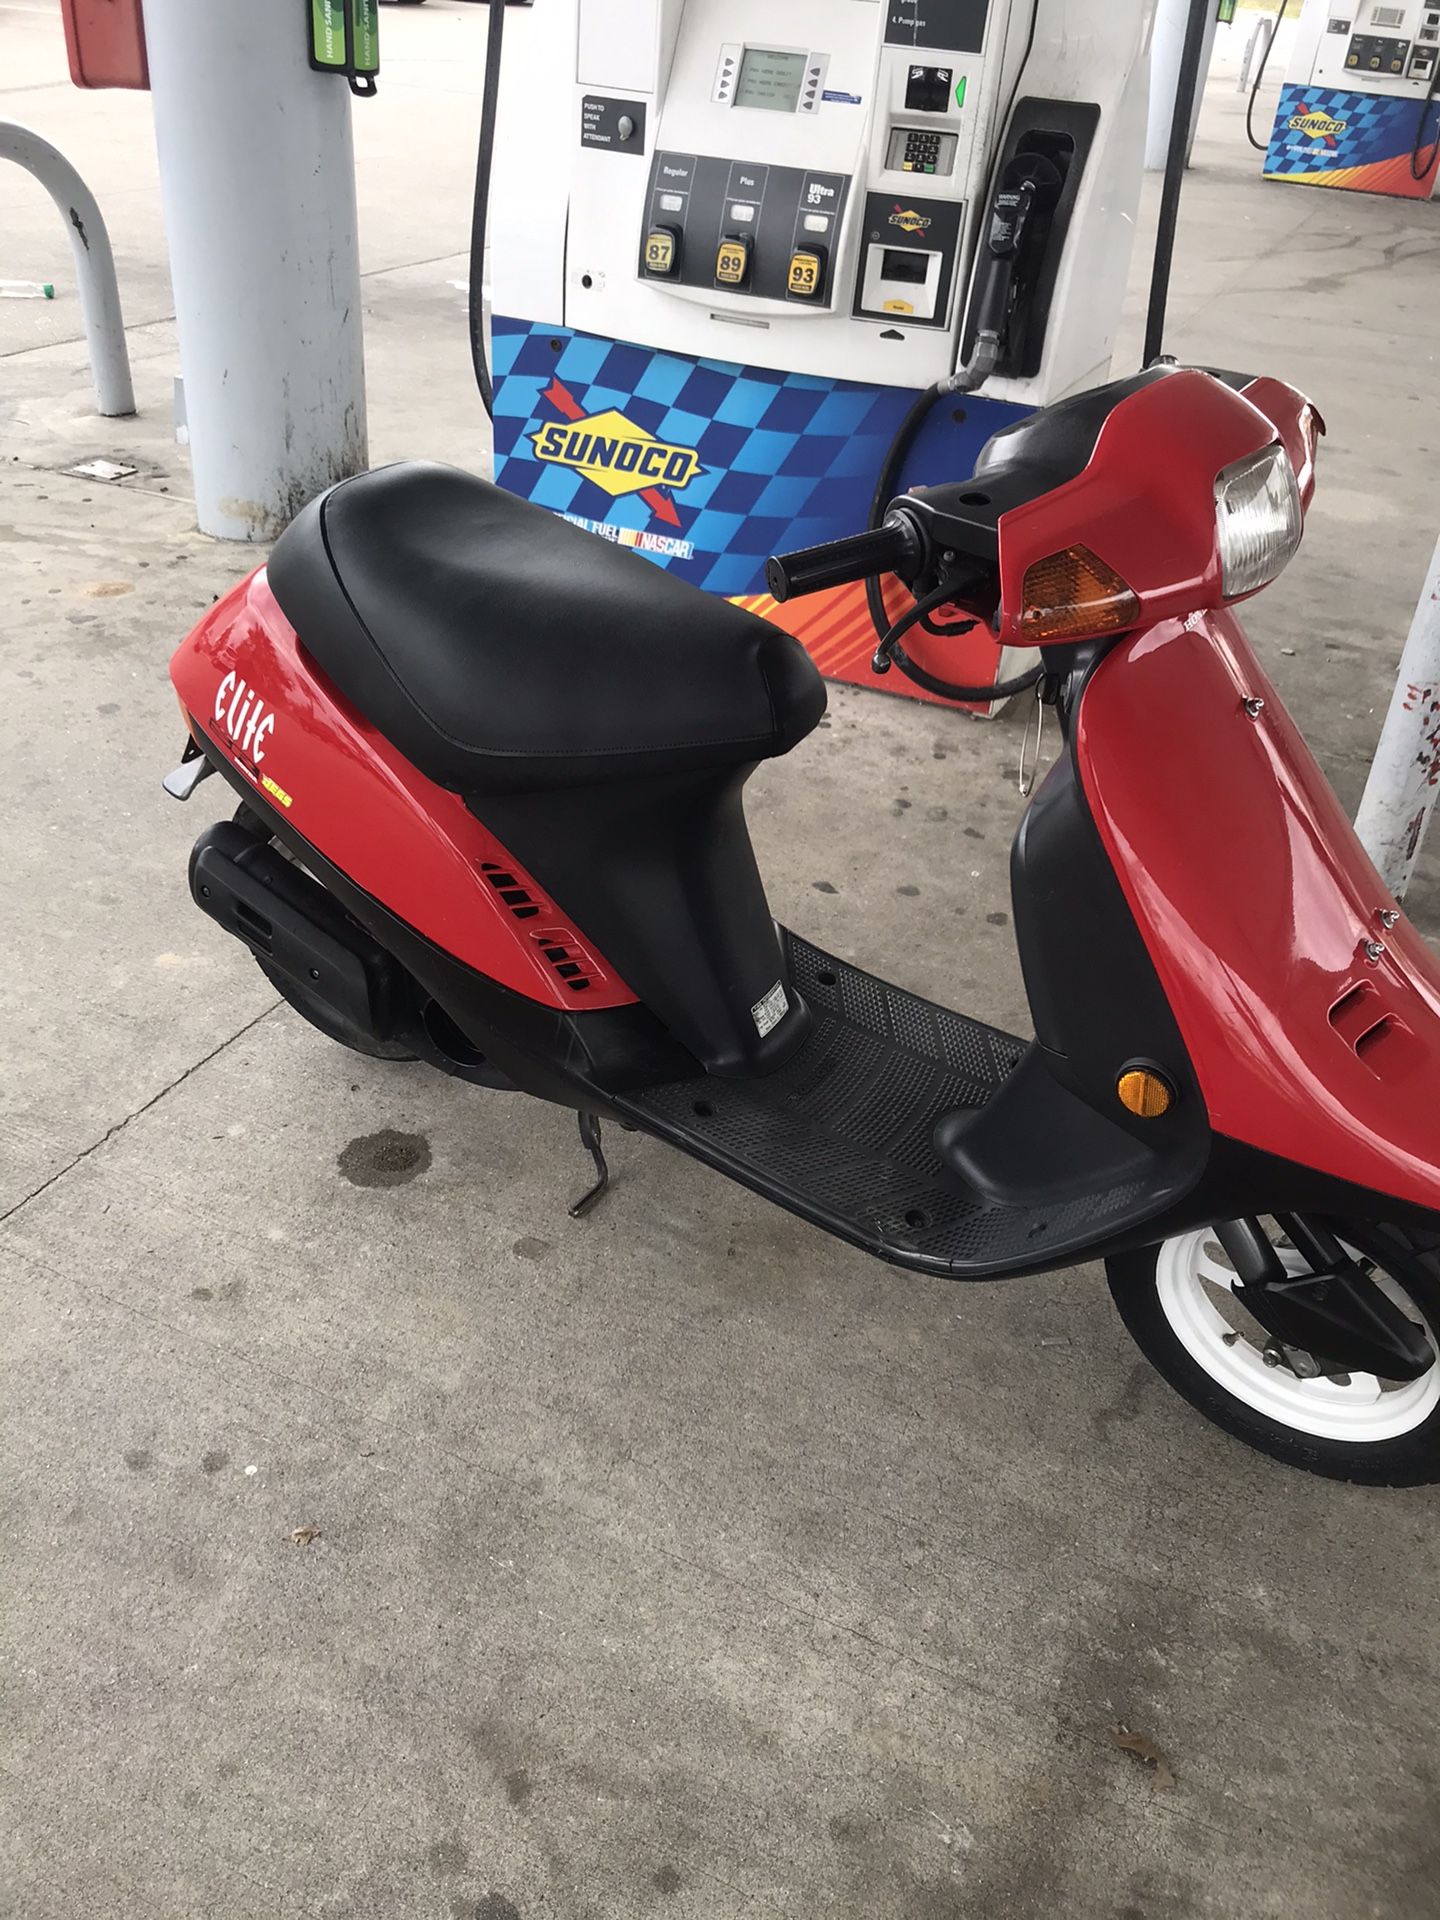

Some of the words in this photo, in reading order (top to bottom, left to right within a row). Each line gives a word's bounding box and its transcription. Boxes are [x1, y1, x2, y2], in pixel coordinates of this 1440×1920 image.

[325, 27, 334, 59] HAND
[584, 102, 597, 111] PUSH
[597, 104, 605, 112] TO
[584, 112, 601, 121] SPEAK
[583, 123, 597, 131] WITH
[1291, 117, 1344, 132] SUNOCO
[583, 133, 611, 142] ATTENDANT
[663, 166, 688, 177] Regular
[740, 176, 755, 186] Plus
[809, 183, 835, 197] Ultra
[807, 194, 821, 204] 93
[890, 215, 930, 227] SUNOCO
[649, 243, 670, 262] 87
[720, 255, 742, 272] 89
[792, 266, 814, 284] 93
[540, 427, 693, 482] SUNOCO
[592, 521, 619, 538] FUEL
[641, 531, 690, 559] NASCAR
